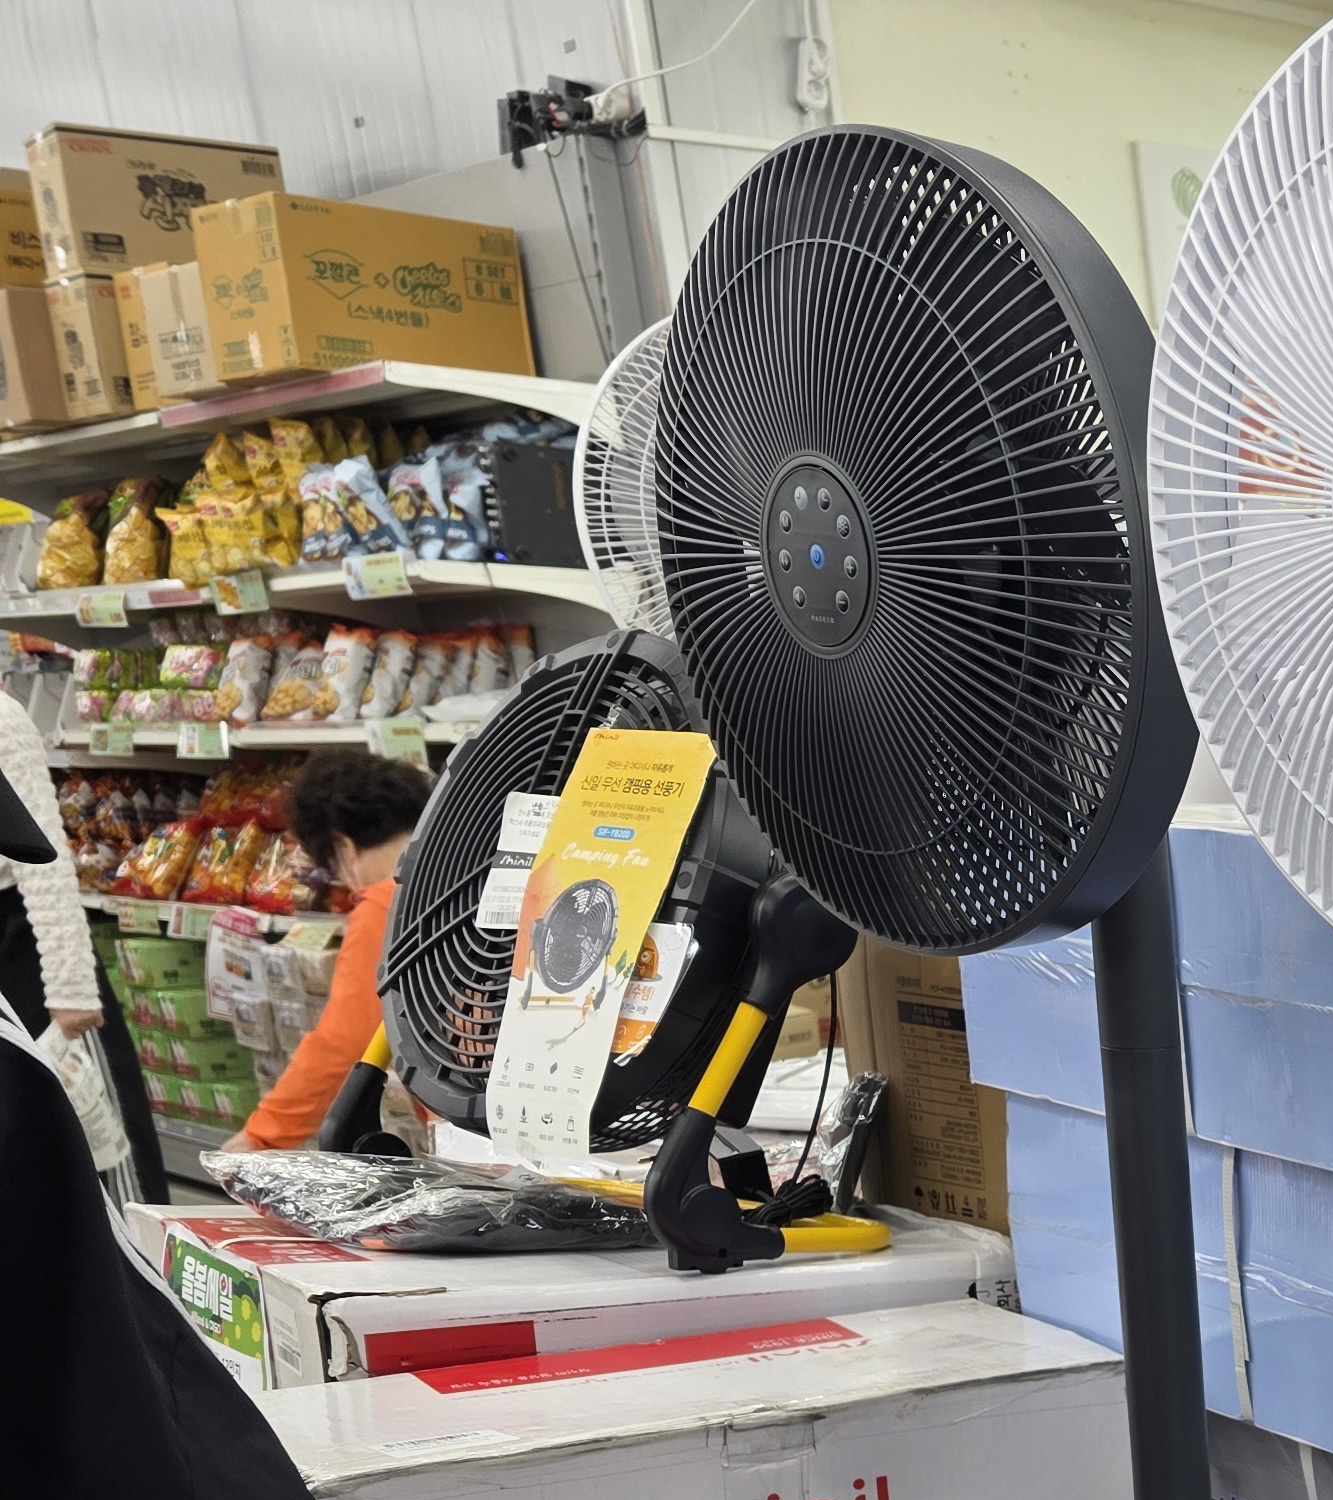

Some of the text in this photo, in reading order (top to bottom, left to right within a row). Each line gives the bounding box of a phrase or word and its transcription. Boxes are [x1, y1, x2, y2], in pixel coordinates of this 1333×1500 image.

[580, 774, 685, 798] 신일 무선 캠핑용 선풍기
[561, 842, 650, 868] Camping Fan
[181, 1255, 233, 1323] 올봄세일
